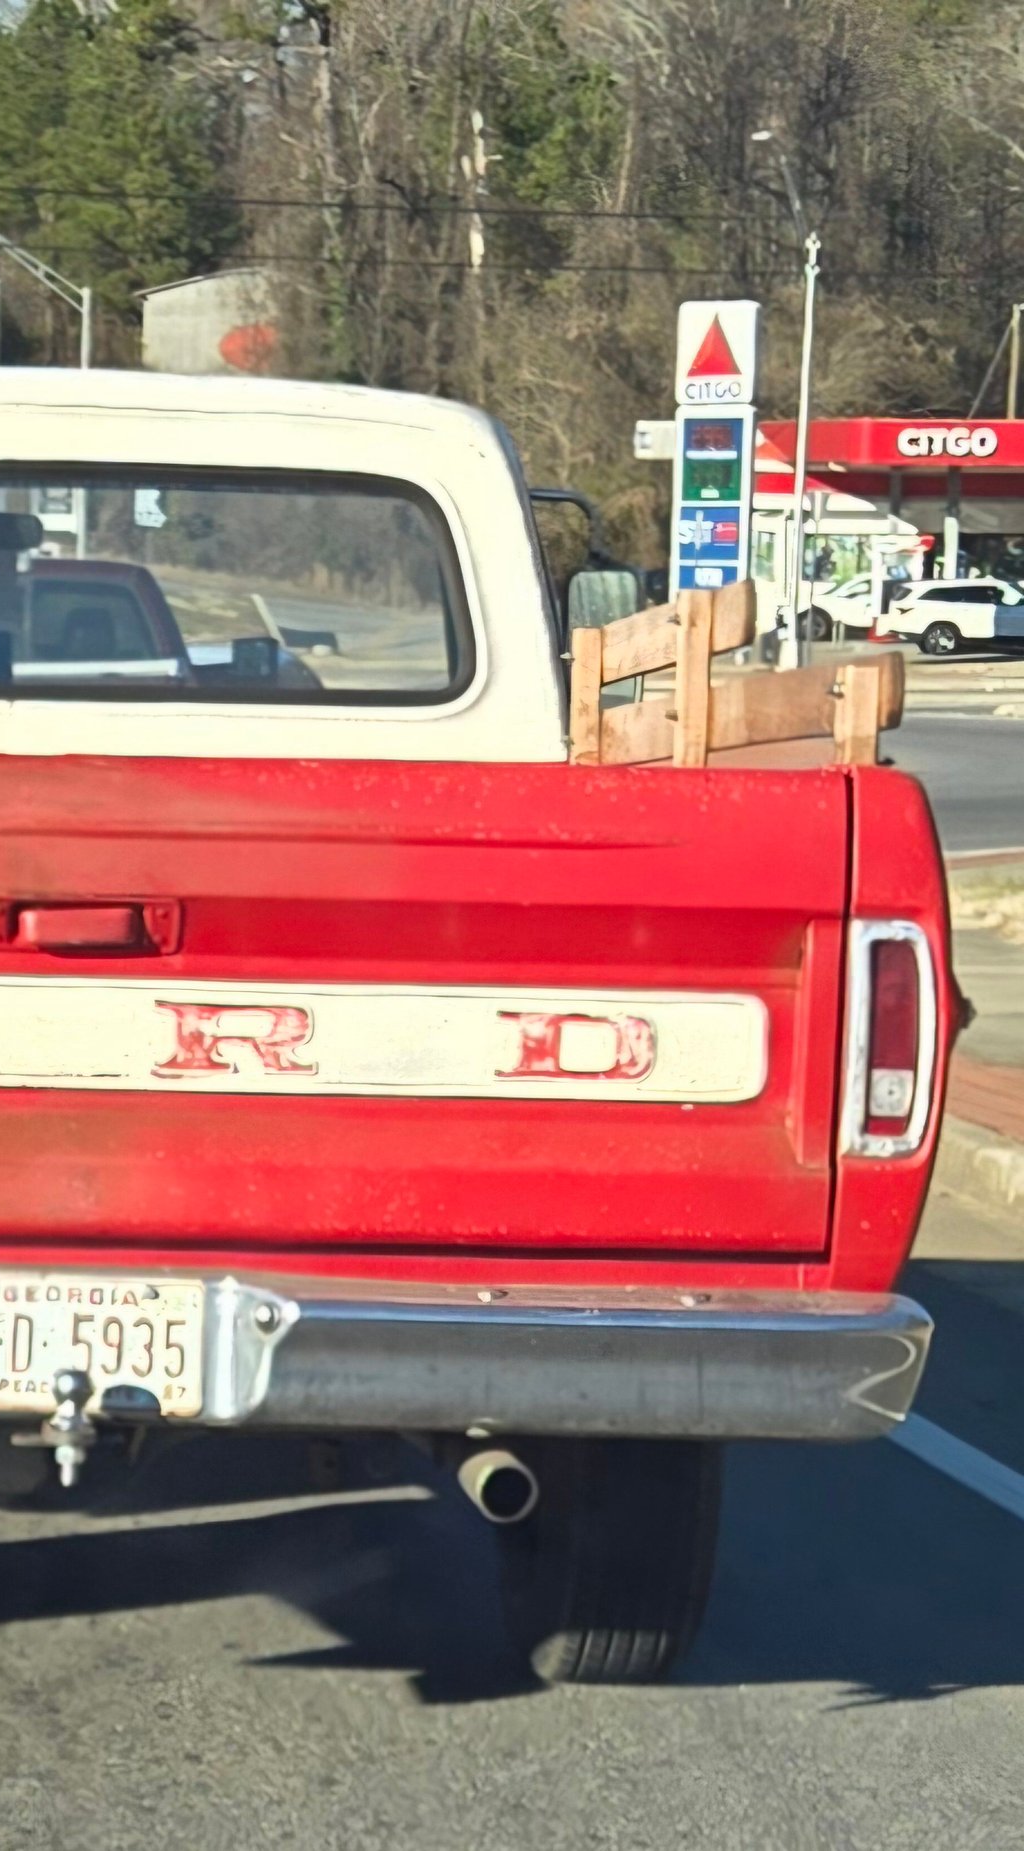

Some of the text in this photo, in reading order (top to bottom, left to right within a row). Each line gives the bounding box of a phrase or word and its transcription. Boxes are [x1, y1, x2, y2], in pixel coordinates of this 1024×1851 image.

[685, 381, 742, 401] CITGO
[897, 426, 998, 457] CITGO
[3, 1285, 140, 1307] GEORGIA
[11, 1312, 34, 1373] D
[71, 1312, 186, 1379] 5935
